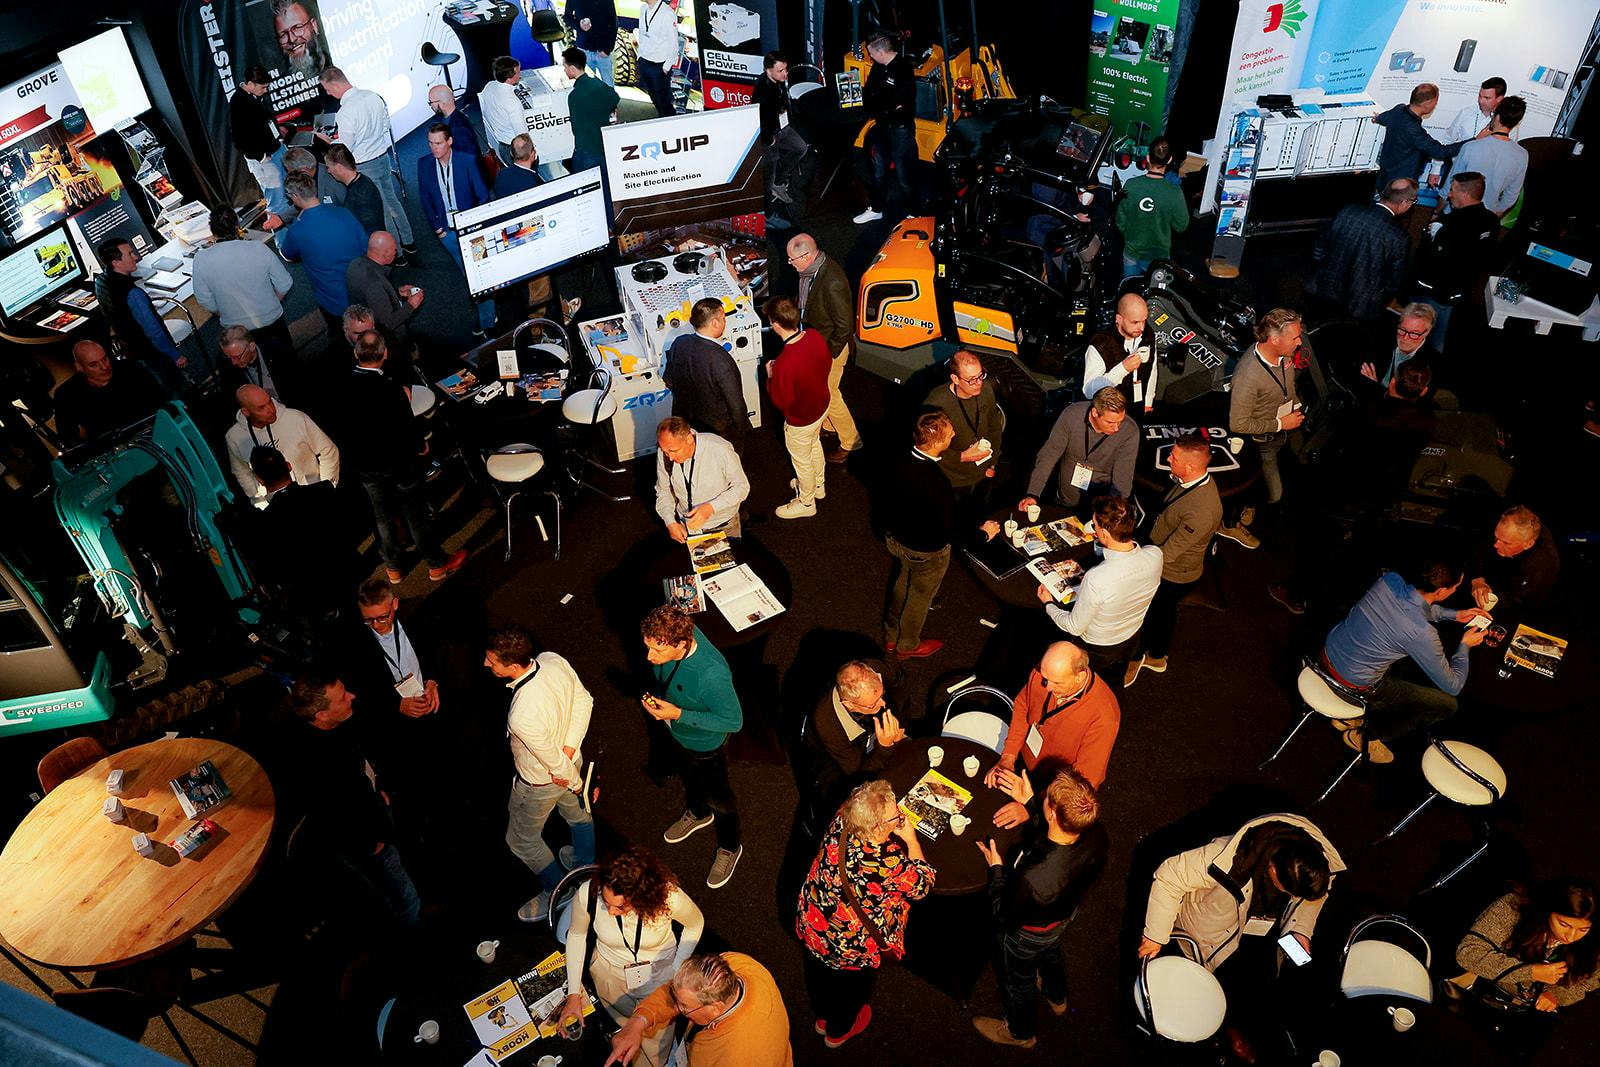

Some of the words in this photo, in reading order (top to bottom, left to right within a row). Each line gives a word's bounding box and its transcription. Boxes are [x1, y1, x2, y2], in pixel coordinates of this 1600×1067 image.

[332, 0, 425, 60] lectrification
[706, 52, 735, 62] CELL
[1241, 47, 1274, 61] Congestie
[708, 61, 748, 72] POWER
[1239, 62, 1252, 71] een
[269, 71, 304, 91] NODIG
[1103, 67, 1121, 78] 100%
[1122, 72, 1148, 84] Electric
[1237, 75, 1253, 84] Maar
[1255, 71, 1266, 80] het
[1267, 66, 1284, 77] biedt
[17, 70, 59, 98] GROVE
[1234, 85, 1247, 94] ook
[1248, 79, 1274, 90] kansen!
[726, 89, 753, 104] inte
[526, 112, 556, 124] CELL
[621, 134, 709, 161] ZQUIP
[623, 169, 658, 180] Machine
[643, 172, 702, 187] Electrification
[1139, 197, 1154, 212] G
[732, 322, 759, 334] ZQUIP
[1170, 326, 1223, 369] GIANT
[1146, 427, 1227, 440] GIANT
[1420, 446, 1446, 457] ANT
[17, 701, 83, 717] SWE20FED
[517, 969, 538, 983] BOUW
[537, 955, 567, 974] MACHINES
[497, 1031, 530, 1057] HOOBY
